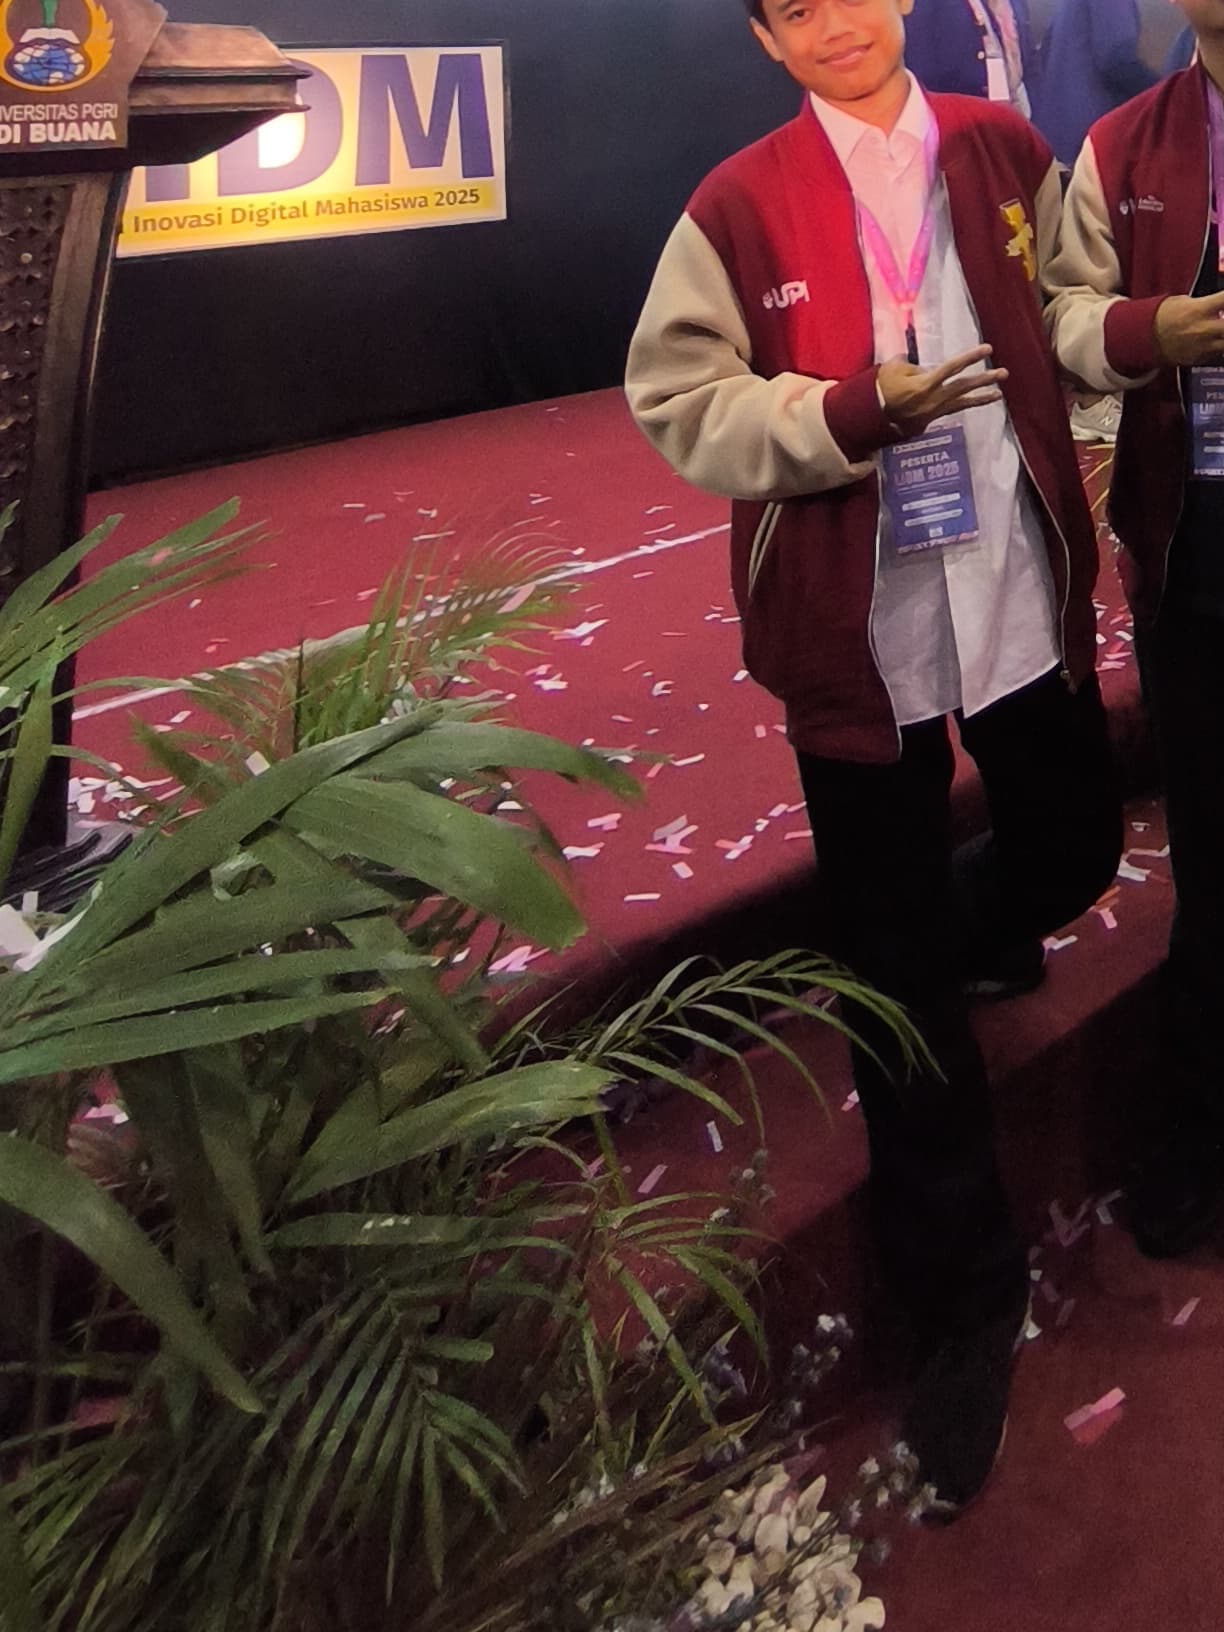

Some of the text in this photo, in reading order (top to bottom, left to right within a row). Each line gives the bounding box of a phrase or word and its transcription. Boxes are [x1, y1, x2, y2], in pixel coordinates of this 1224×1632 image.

[82, 104, 118, 120] PGRI
[30, 121, 117, 143] BUANA
[134, 188, 481, 234] Inovasi Digital Mahasiswa 2025
